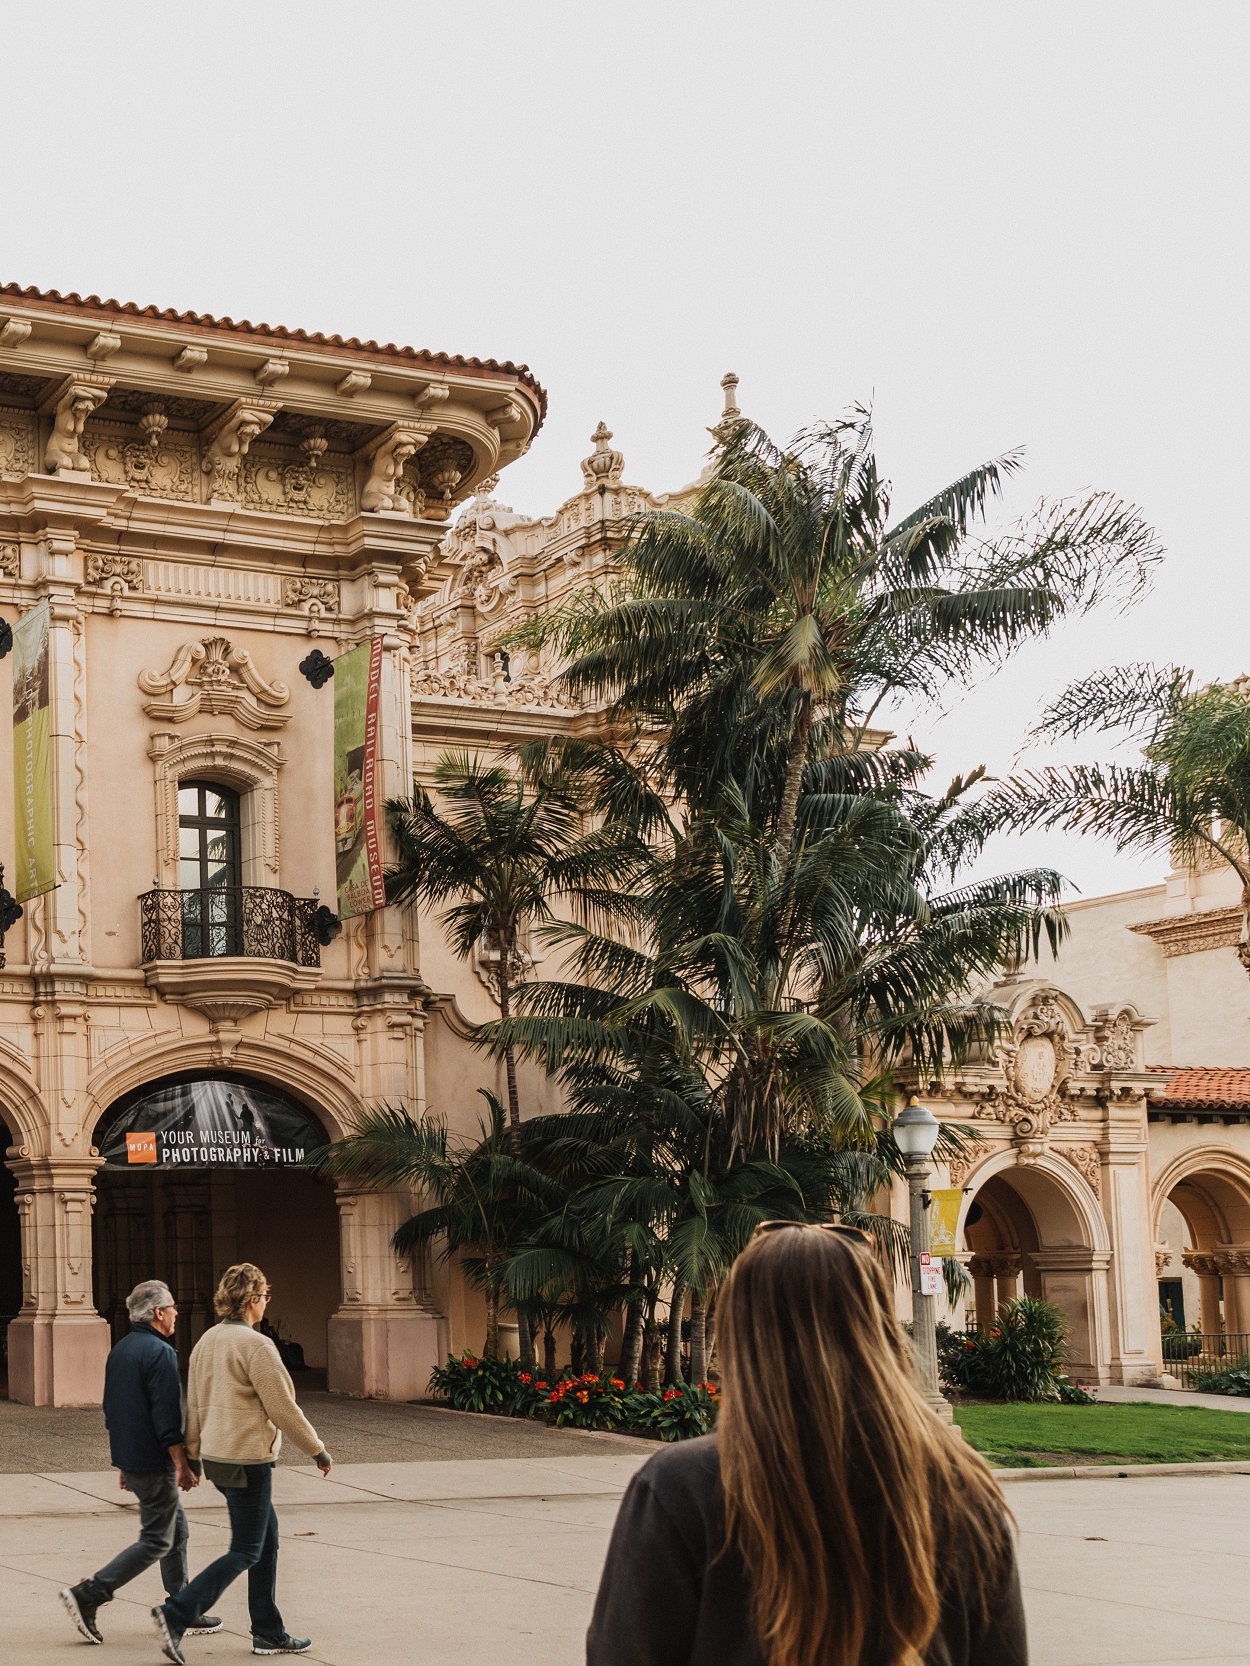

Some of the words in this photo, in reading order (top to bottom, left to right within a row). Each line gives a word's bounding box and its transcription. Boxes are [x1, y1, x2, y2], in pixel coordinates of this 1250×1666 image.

[369, 638, 382, 704] MODEL
[365, 712, 377, 810] RAILROAD
[25, 714, 35, 848] PHOTOGRAPHIC
[366, 820, 384, 905] MUSEUM
[28, 857, 39, 898] ARTS
[345, 884, 359, 893] CASA
[360, 879, 369, 888] DE
[346, 888, 370, 901] BALBOA
[350, 896, 371, 907] LOWER
[160, 1130, 195, 1144] YOUR
[199, 1130, 251, 1144] MUSEUM
[255, 1136, 266, 1144] for
[130, 1143, 154, 1151] MOPA
[162, 1147, 259, 1163] PHOTOGRAPHY
[263, 1150, 270, 1160] &
[274, 1148, 305, 1163] FILM
[921, 1254, 929, 1264] NO
[922, 1266, 941, 1275] STOPPING
